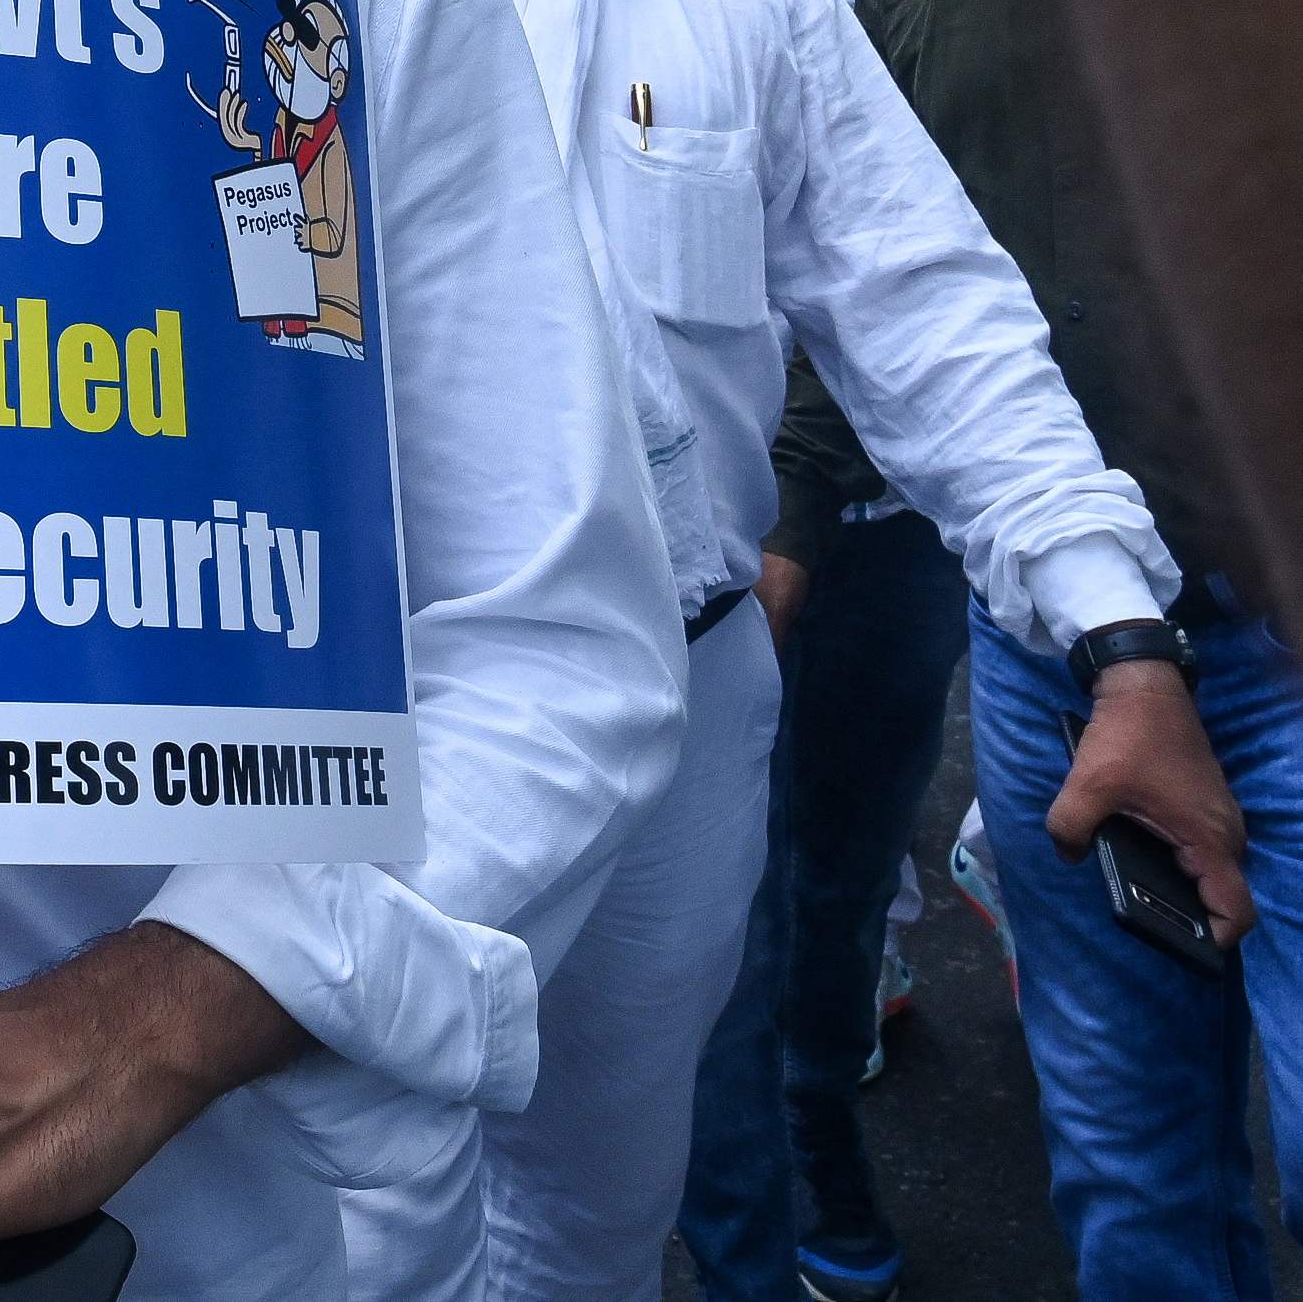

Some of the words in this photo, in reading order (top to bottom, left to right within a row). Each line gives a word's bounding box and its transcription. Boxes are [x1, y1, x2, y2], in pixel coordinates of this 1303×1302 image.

[223, 181, 292, 209] Pegasus
[236, 207, 294, 236] Project
[152, 741, 392, 809] COMMITTEE
